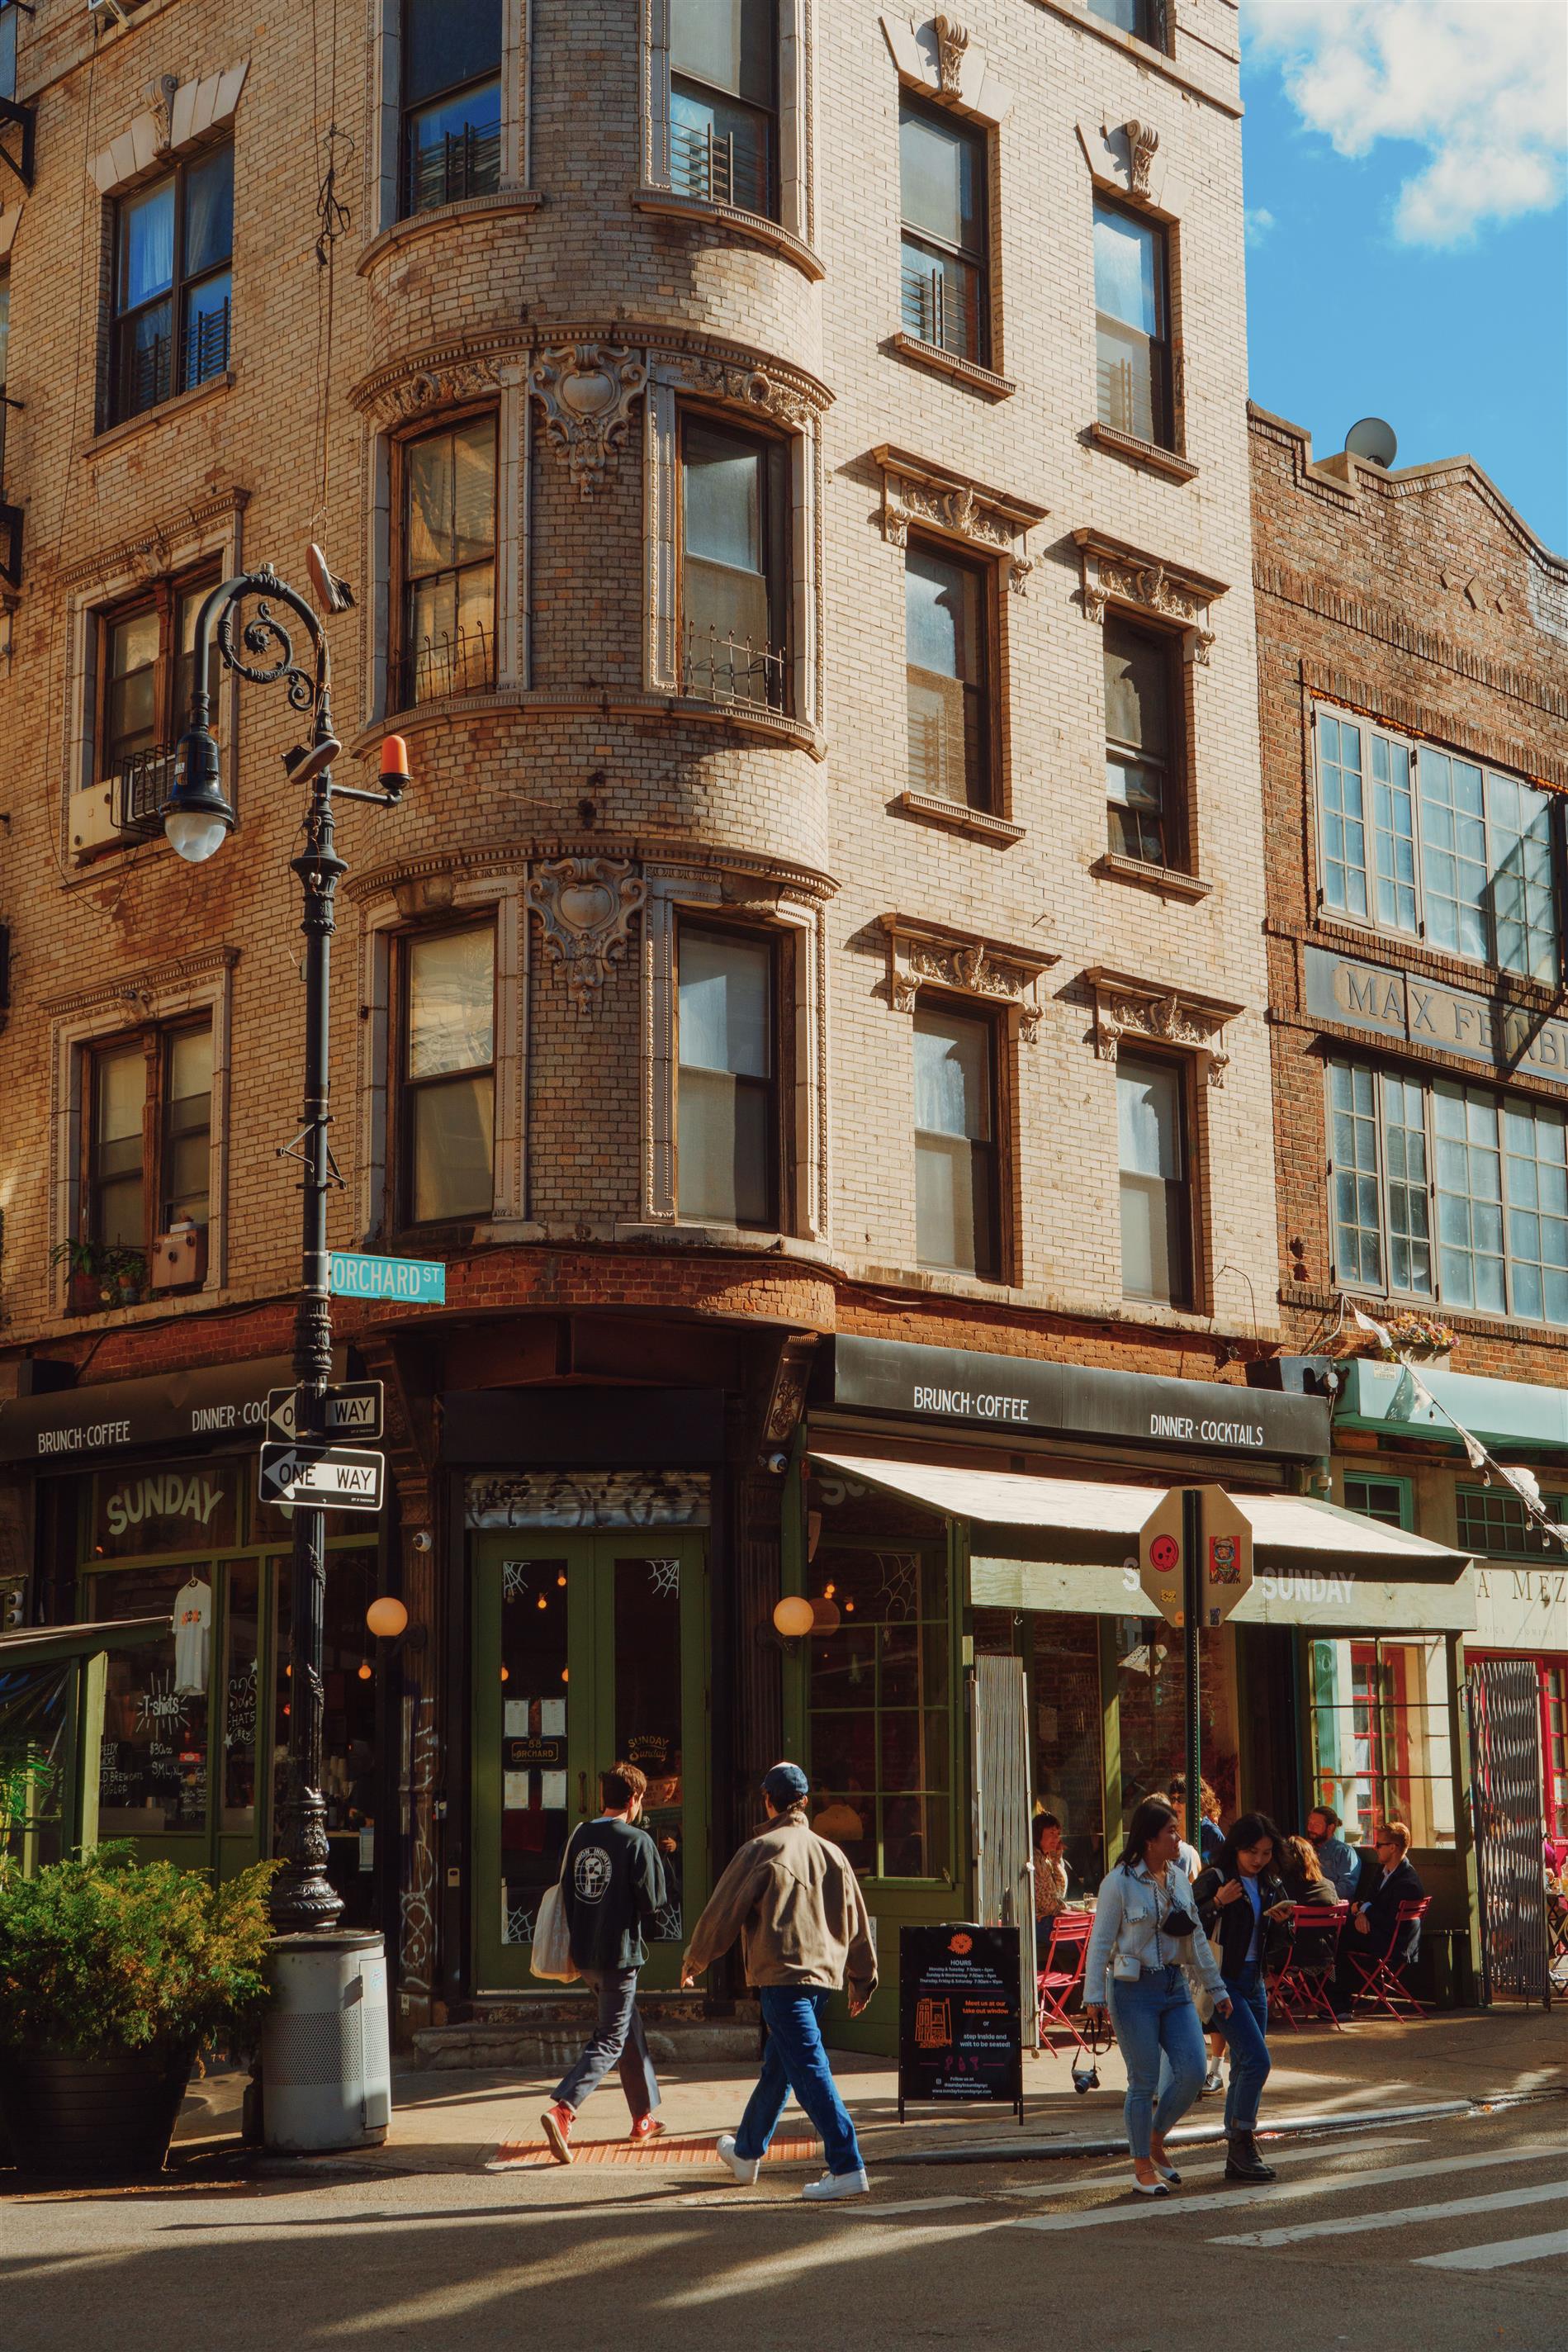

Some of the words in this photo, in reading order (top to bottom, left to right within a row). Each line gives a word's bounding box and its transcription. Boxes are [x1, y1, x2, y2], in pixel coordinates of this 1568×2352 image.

[1347, 970, 1436, 1032] MAX
[334, 1259, 420, 1295] ORCHARD
[423, 1268, 439, 1283] ST
[335, 1400, 371, 1422] WAY
[914, 1387, 969, 1414] BRUNCH
[977, 1395, 1029, 1421] COFFEE
[192, 1406, 234, 1431] DINNER
[1150, 1414, 1193, 1439] DINNER
[1201, 1420, 1263, 1446] COCKTAILS
[38, 1427, 82, 1454] BRUNCH
[87, 1420, 130, 1447] COFFEE
[279, 1463, 316, 1486] ONE
[337, 1468, 372, 1491] WAY
[107, 1474, 225, 1535] SUNDAY
[1262, 1566, 1355, 1604] SUNDAY
[231, 1710, 256, 1728] HATS
[515, 1750, 554, 1758] ORCHARD
[527, 1738, 542, 1749] 88
[628, 1736, 670, 1748] SUNDAY
[629, 1746, 668, 1762] Sunday
